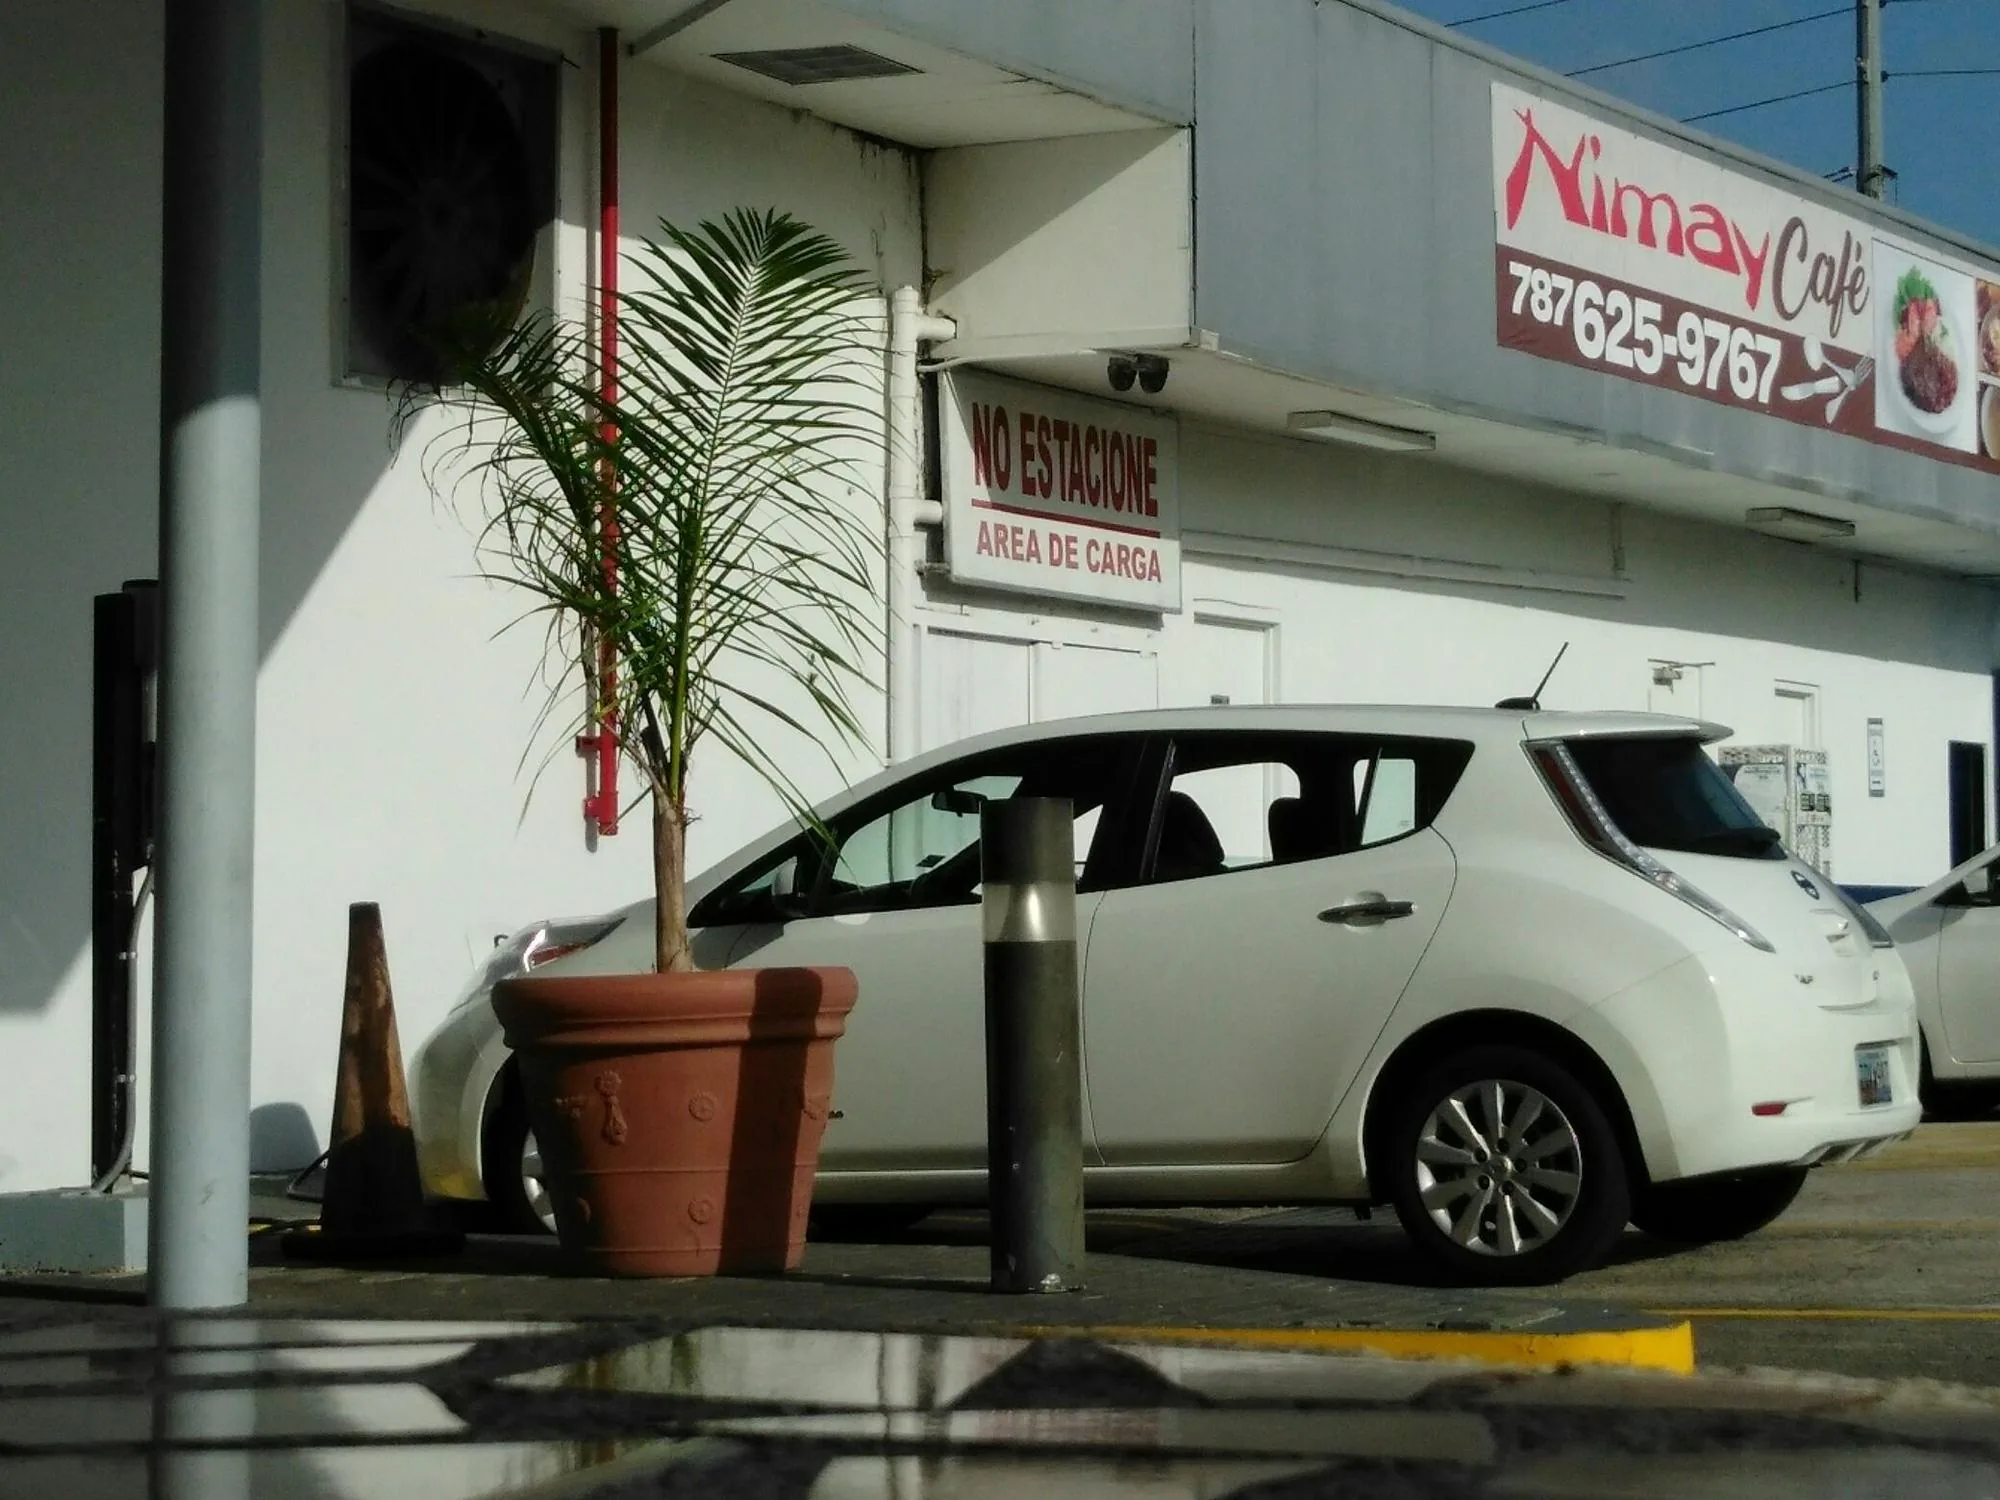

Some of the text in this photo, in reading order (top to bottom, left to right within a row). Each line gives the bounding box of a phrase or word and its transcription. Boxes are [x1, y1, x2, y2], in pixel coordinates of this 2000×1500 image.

[1505, 106, 1870, 338] Nimay Café
[972, 402, 1158, 517] NO ESTACIONE
[976, 520, 1162, 582] AREA DE CARGA
